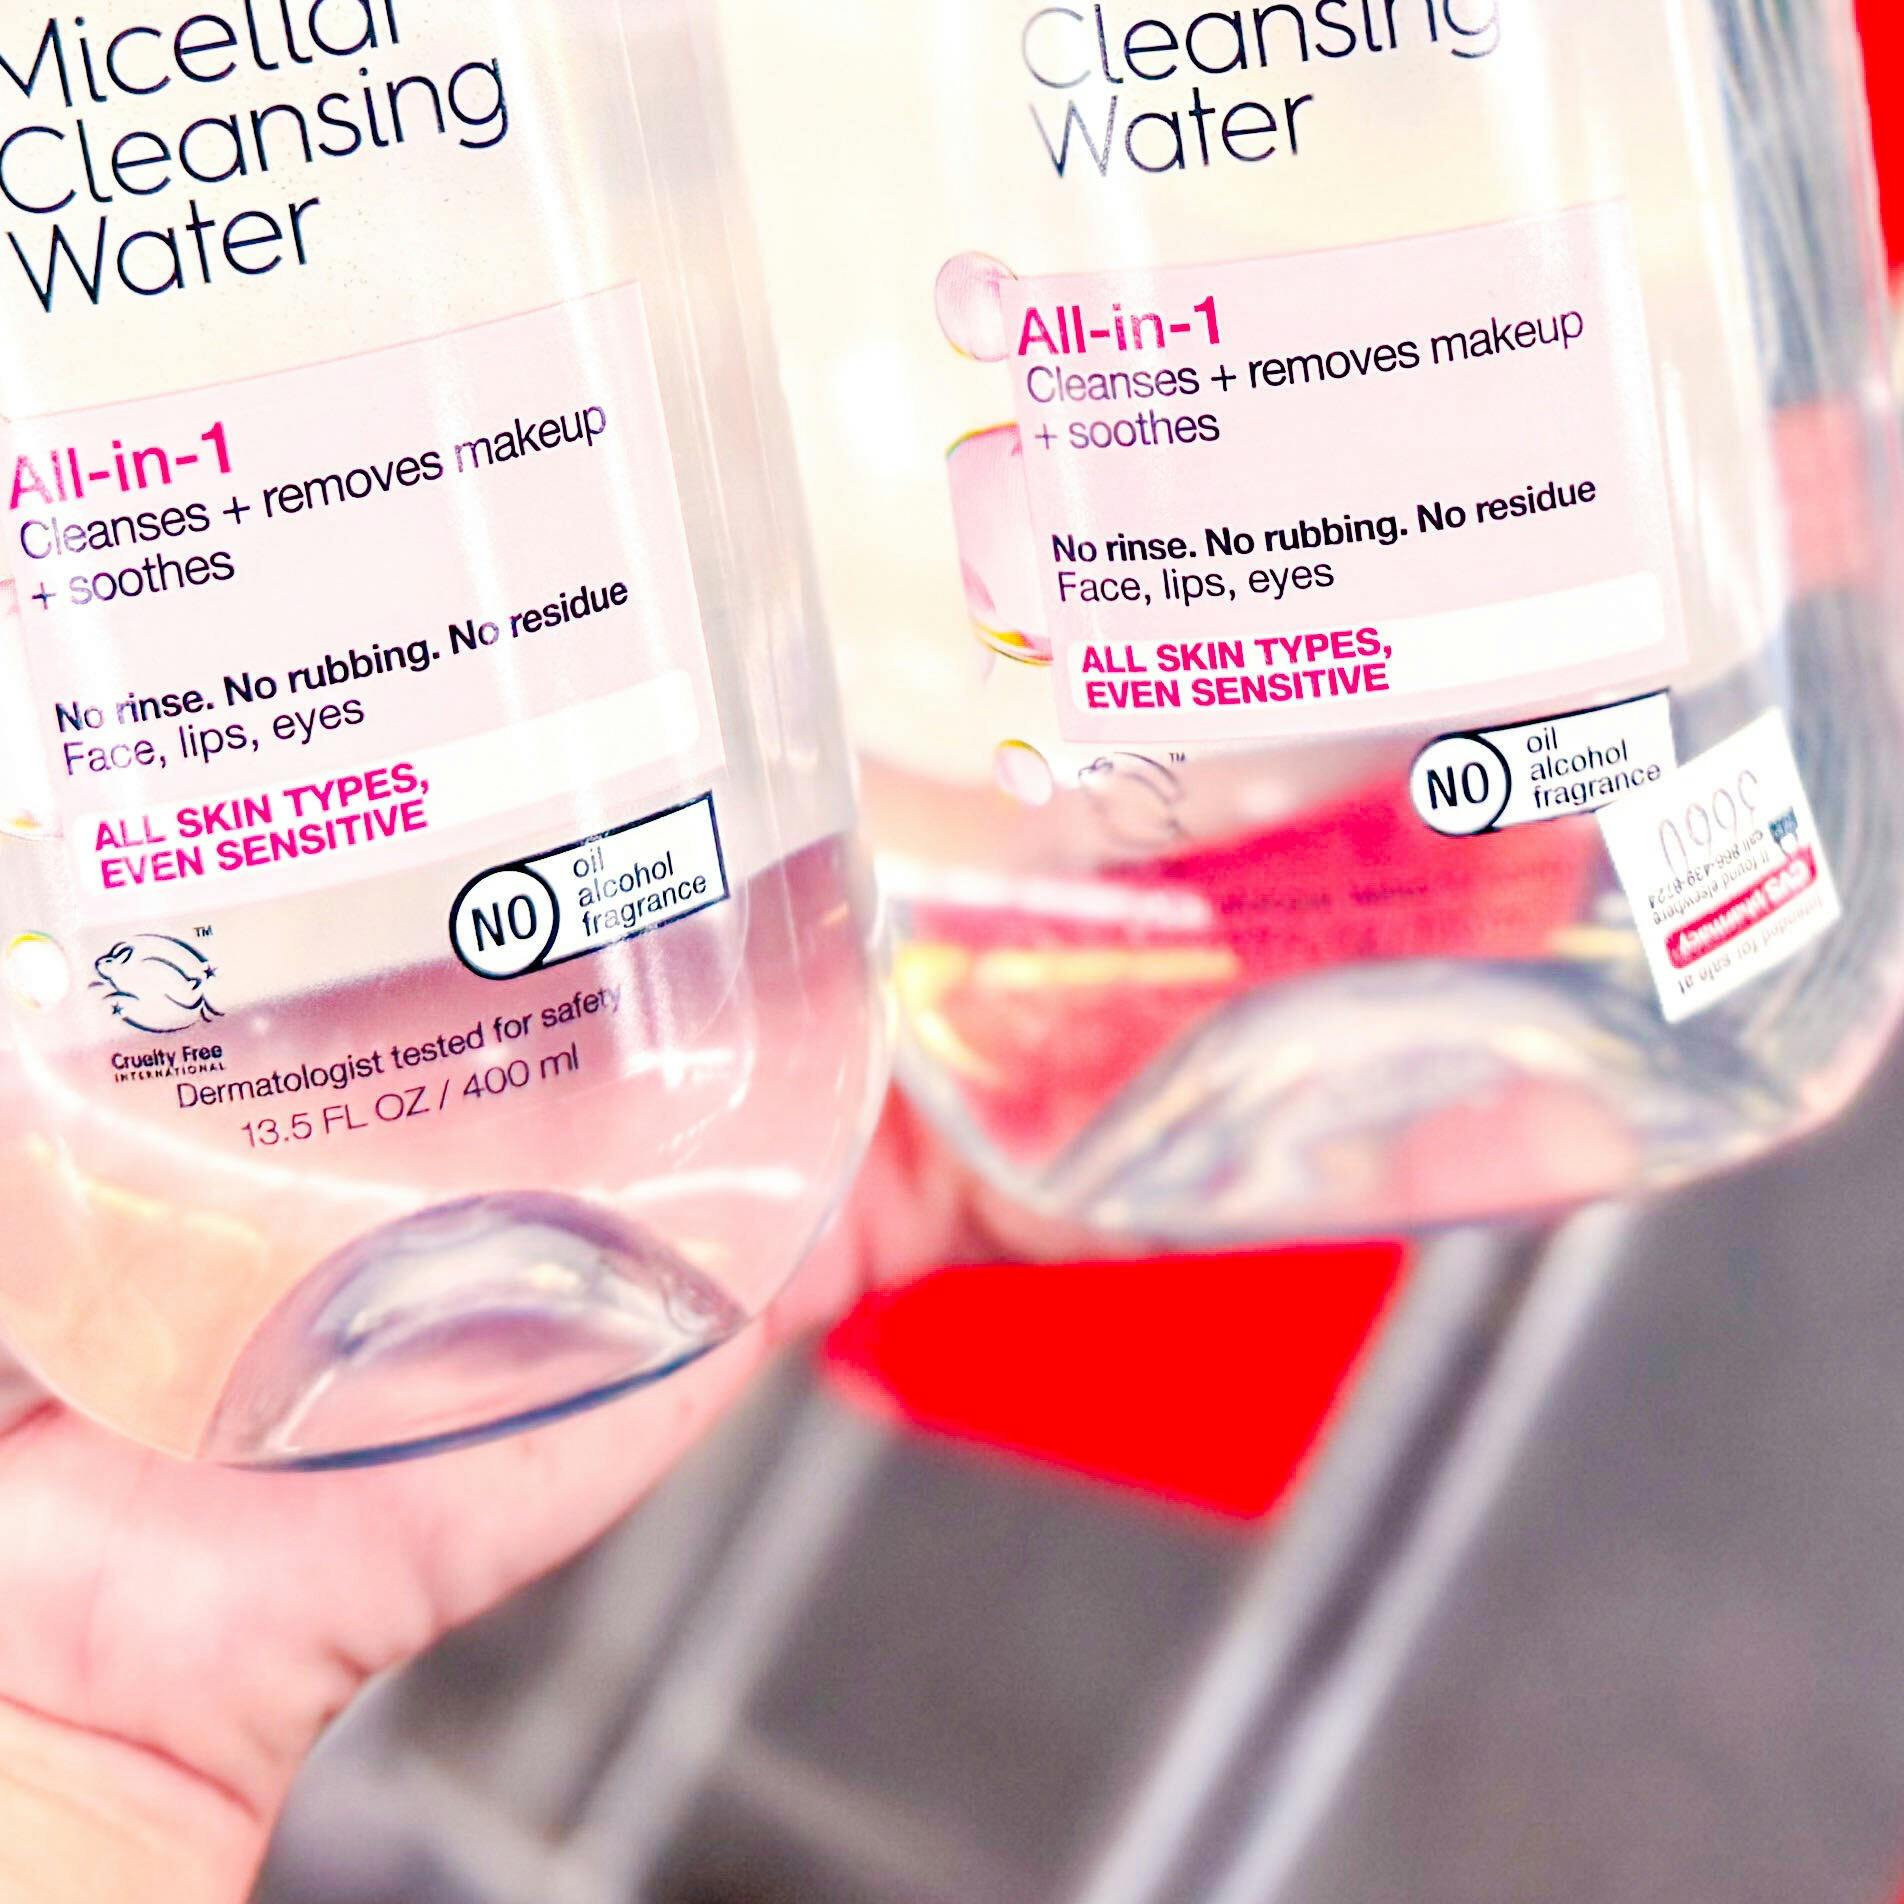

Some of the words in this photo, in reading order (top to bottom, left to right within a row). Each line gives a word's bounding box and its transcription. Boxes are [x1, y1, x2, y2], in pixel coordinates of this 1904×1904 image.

[1029, 86, 1314, 177] Water
[7, 197, 320, 312] Water
[1018, 297, 1222, 355] All-in-1
[1027, 359, 1199, 402] Cleanses
[1212, 368, 1236, 390] +
[1249, 337, 1419, 389] removes
[1432, 307, 1583, 365] makeup
[1034, 427, 1057, 448] +
[1069, 410, 1219, 449] soothes
[8, 422, 233, 508] All-in-1
[19, 504, 210, 560] Cleanses
[223, 498, 250, 526] +
[263, 449, 444, 519] removes
[455, 402, 607, 473] makeup
[1051, 534, 1096, 562] No
[1106, 529, 1195, 560] rinse.
[1206, 527, 1255, 556] No
[1265, 512, 1407, 557] rubbing.
[1417, 501, 1465, 530] No
[1476, 477, 1596, 524] residue
[32, 582, 57, 611] +
[69, 548, 235, 608] soothes
[1058, 569, 1151, 604] Face,
[1162, 567, 1235, 606] lips,
[1249, 559, 1334, 599] eyes
[55, 701, 103, 732] No
[116, 685, 213, 726] rinse.
[224, 672, 276, 707] No
[289, 637, 440, 698] rubbing.
[449, 621, 498, 655] No
[509, 580, 628, 638] residue
[1082, 643, 1146, 673] ALL
[1157, 639, 1245, 671] SKIN
[1256, 627, 1392, 666] TYPES,
[1086, 676, 1182, 707] EVEN
[1192, 663, 1390, 705] SENSITIVE
[63, 734, 166, 776] Face,
[180, 719, 258, 762] lips,
[273, 698, 365, 747] eyes
[1526, 726, 1556, 754] oil
[1530, 740, 1628, 781] alcohol
[95, 812, 167, 852] ALL
[177, 795, 273, 838] SKIN
[286, 762, 430, 818] TYPES,
[1428, 761, 1488, 808] NO
[1533, 759, 1661, 813] fragrance
[101, 849, 205, 890] EVEN
[217, 799, 428, 871] SENSITIVE
[572, 847, 605, 877] oil
[579, 852, 674, 907] alcohol
[582, 872, 707, 936] fragrance
[1764, 859, 1811, 902] CVS
[472, 894, 534, 951] NO
[111, 1048, 175, 1070] Cruelty
[182, 1045, 222, 1062] Free
[115, 1062, 225, 1082] INTERNATIONAL
[178, 1048, 383, 1109] Dermatologist
[391, 1026, 485, 1069] tested
[494, 1010, 533, 1043] for
[542, 983, 622, 1030] safety
[241, 1114, 313, 1148] 13.5
[326, 1102, 368, 1133] FL
[376, 1087, 431, 1123] OZ
[438, 1079, 449, 1109] /
[464, 1066, 530, 1101] 400
[540, 1043, 580, 1079] ml
